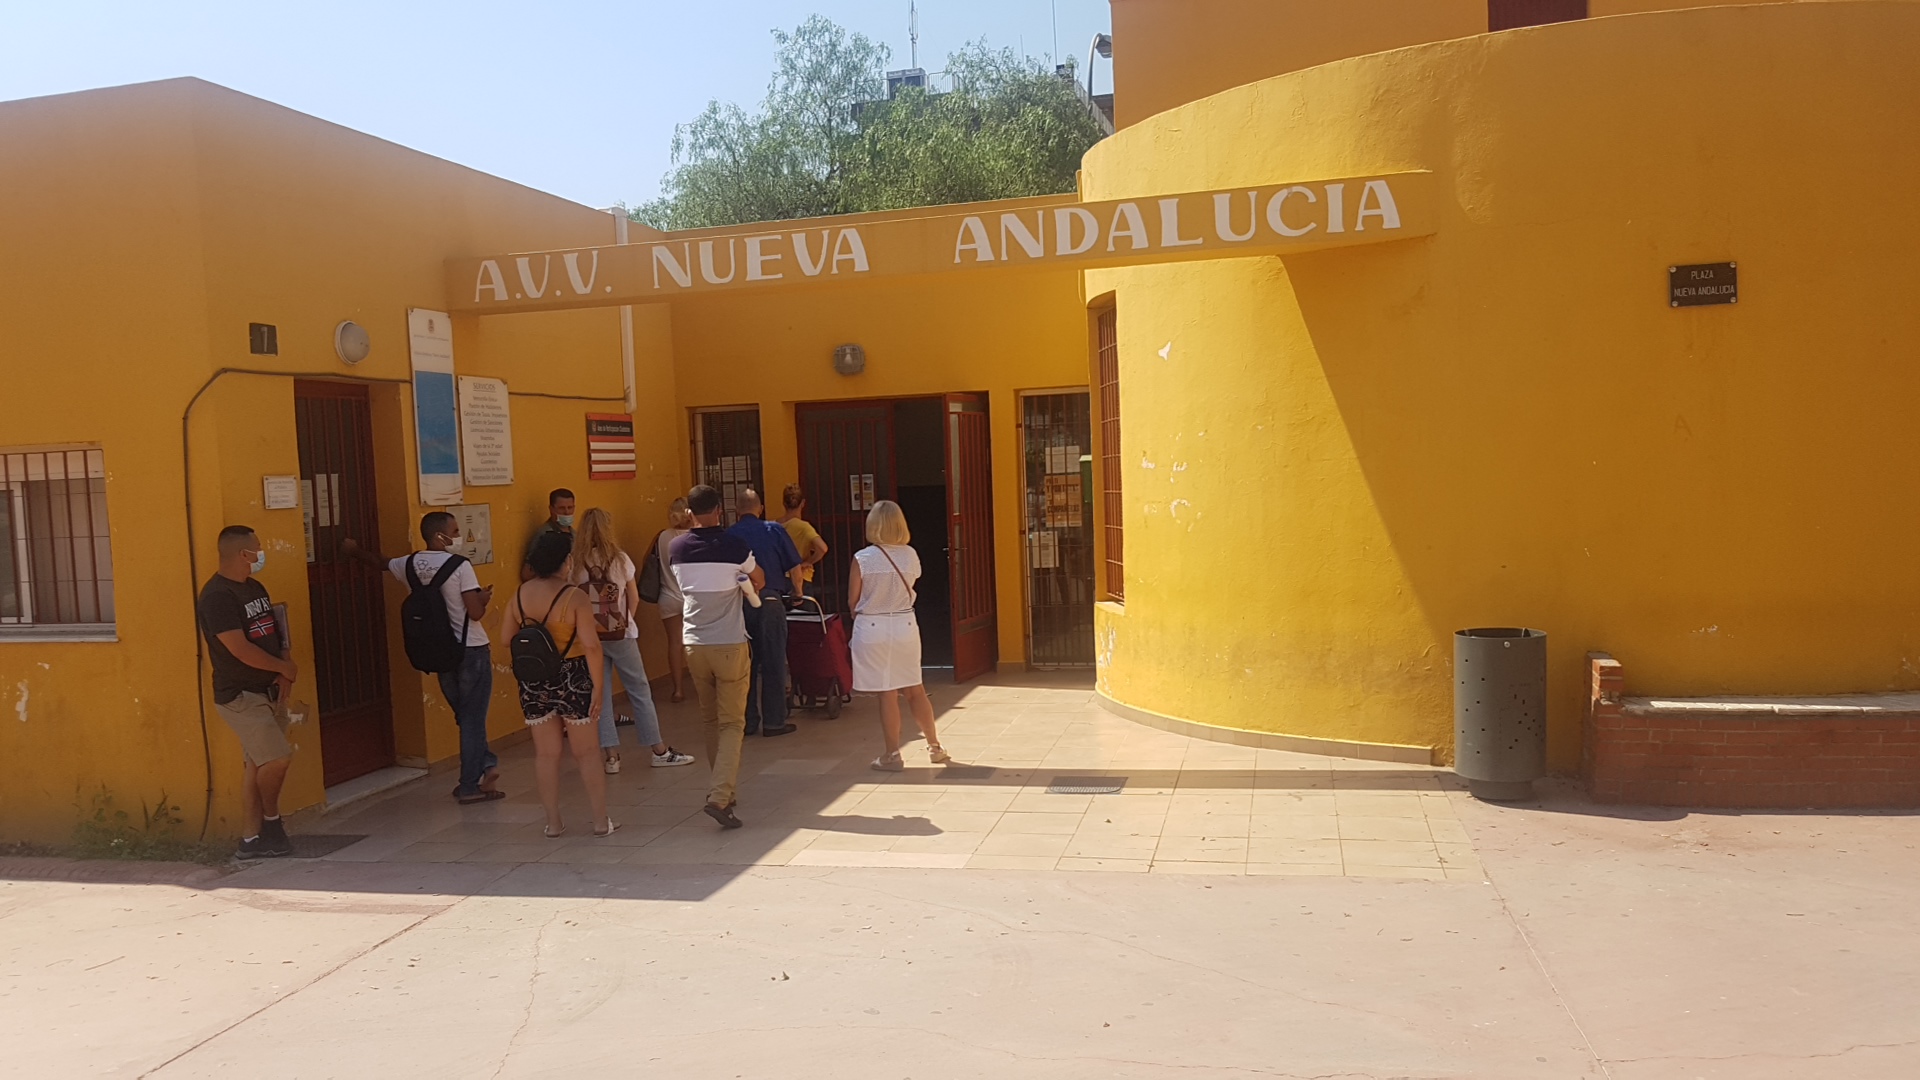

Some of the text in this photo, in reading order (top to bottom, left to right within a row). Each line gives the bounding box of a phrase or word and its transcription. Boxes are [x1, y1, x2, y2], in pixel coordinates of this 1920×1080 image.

[475, 180, 1401, 302] A.V.V. NUEVA ANDALUCIA
[1691, 270, 1714, 280] PLAZA
[1674, 285, 1735, 297] NUEVA ANDALUCIA
[260, 326, 268, 353] 1
